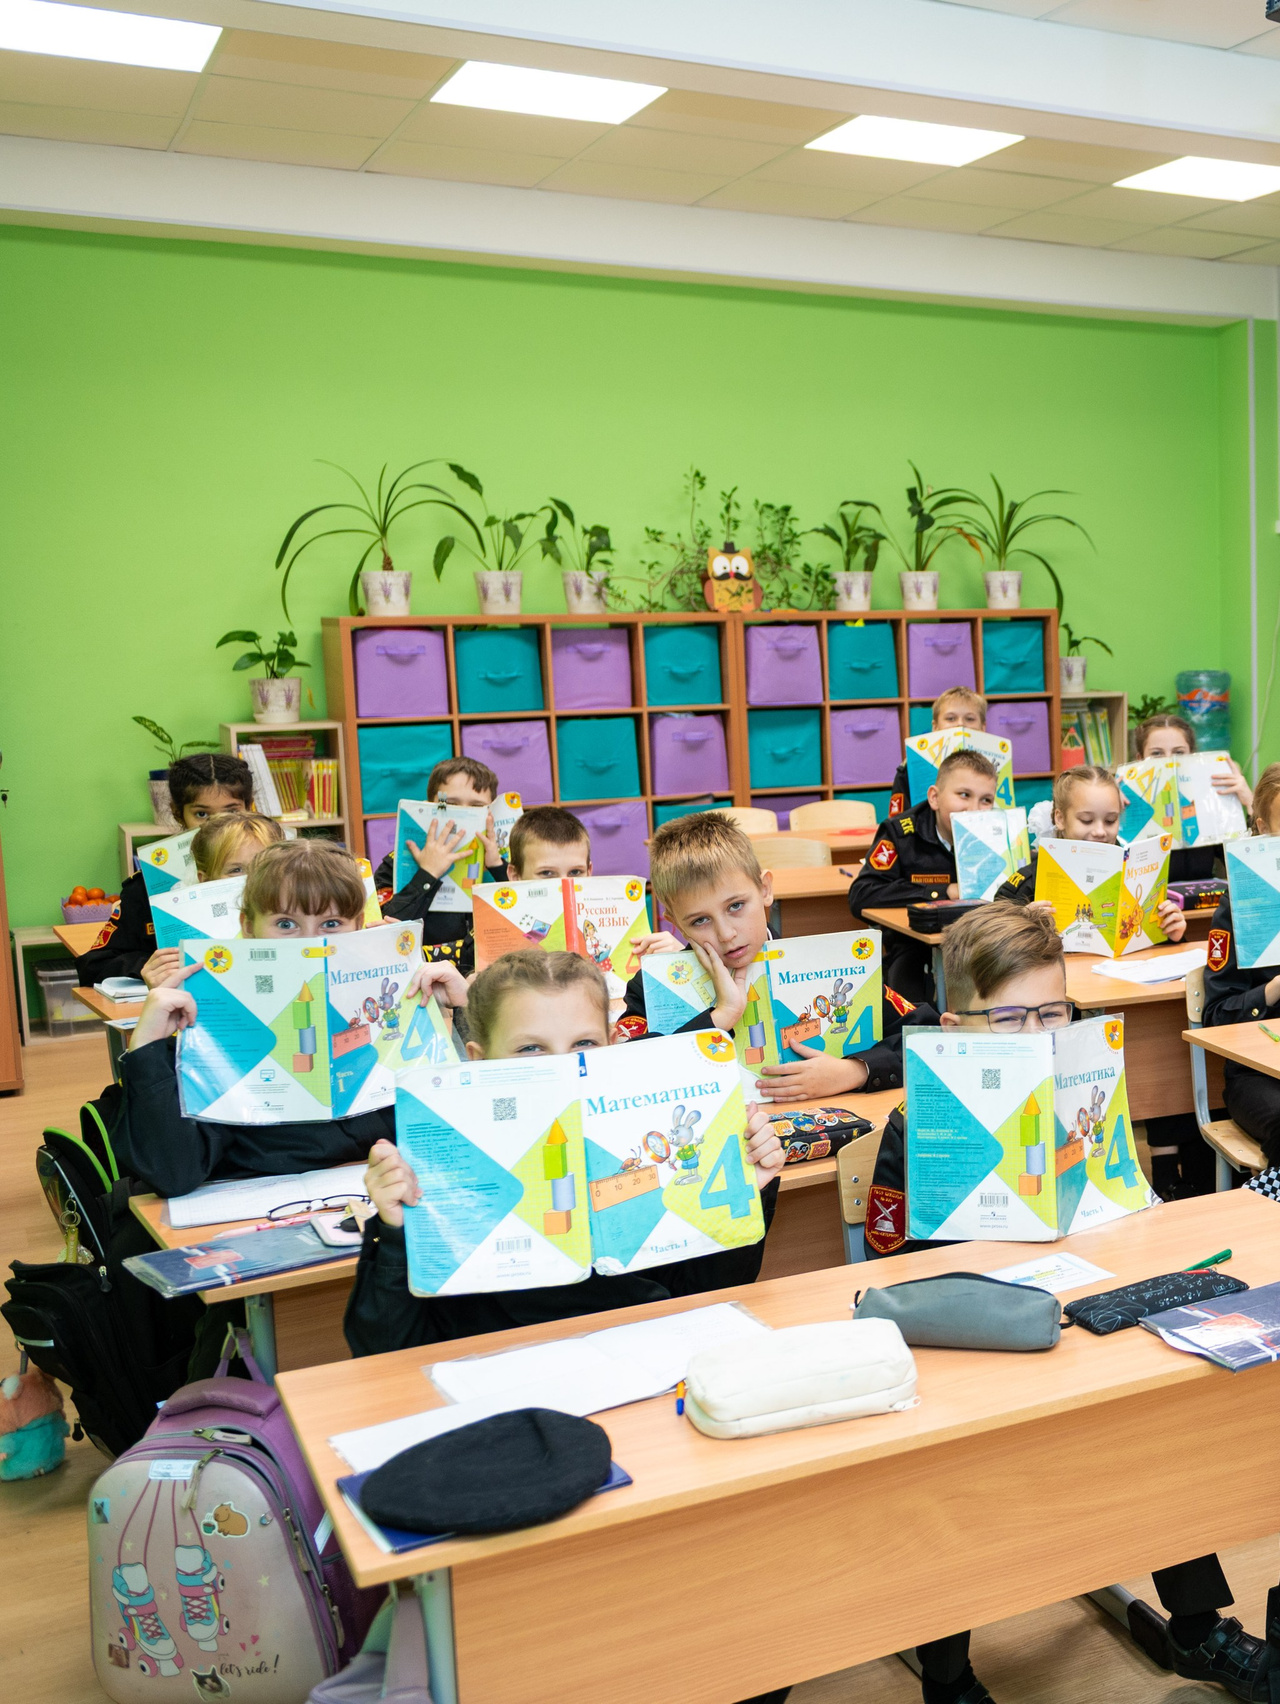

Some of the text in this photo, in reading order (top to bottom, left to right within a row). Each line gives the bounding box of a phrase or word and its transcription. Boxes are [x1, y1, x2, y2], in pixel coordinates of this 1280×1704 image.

[996, 776, 1013, 806] 4
[1126, 862, 1160, 880] Музыка
[577, 902, 618, 918] Русский
[330, 962, 409, 987] Математика
[778, 964, 867, 986] Математика
[400, 1004, 448, 1065] 4
[1054, 1064, 1116, 1091] Математика
[586, 1080, 722, 1117] Математика
[1104, 1113, 1139, 1189] 4
[614, 1182, 623, 1191] 10
[632, 1177, 641, 1186] 20
[648, 1173, 657, 1181] 30
[699, 1133, 756, 1219] 4
[1080, 1208, 1099, 1219] Часть
[650, 1239, 681, 1255] Часть
[245, 1660, 270, 1676] ride
